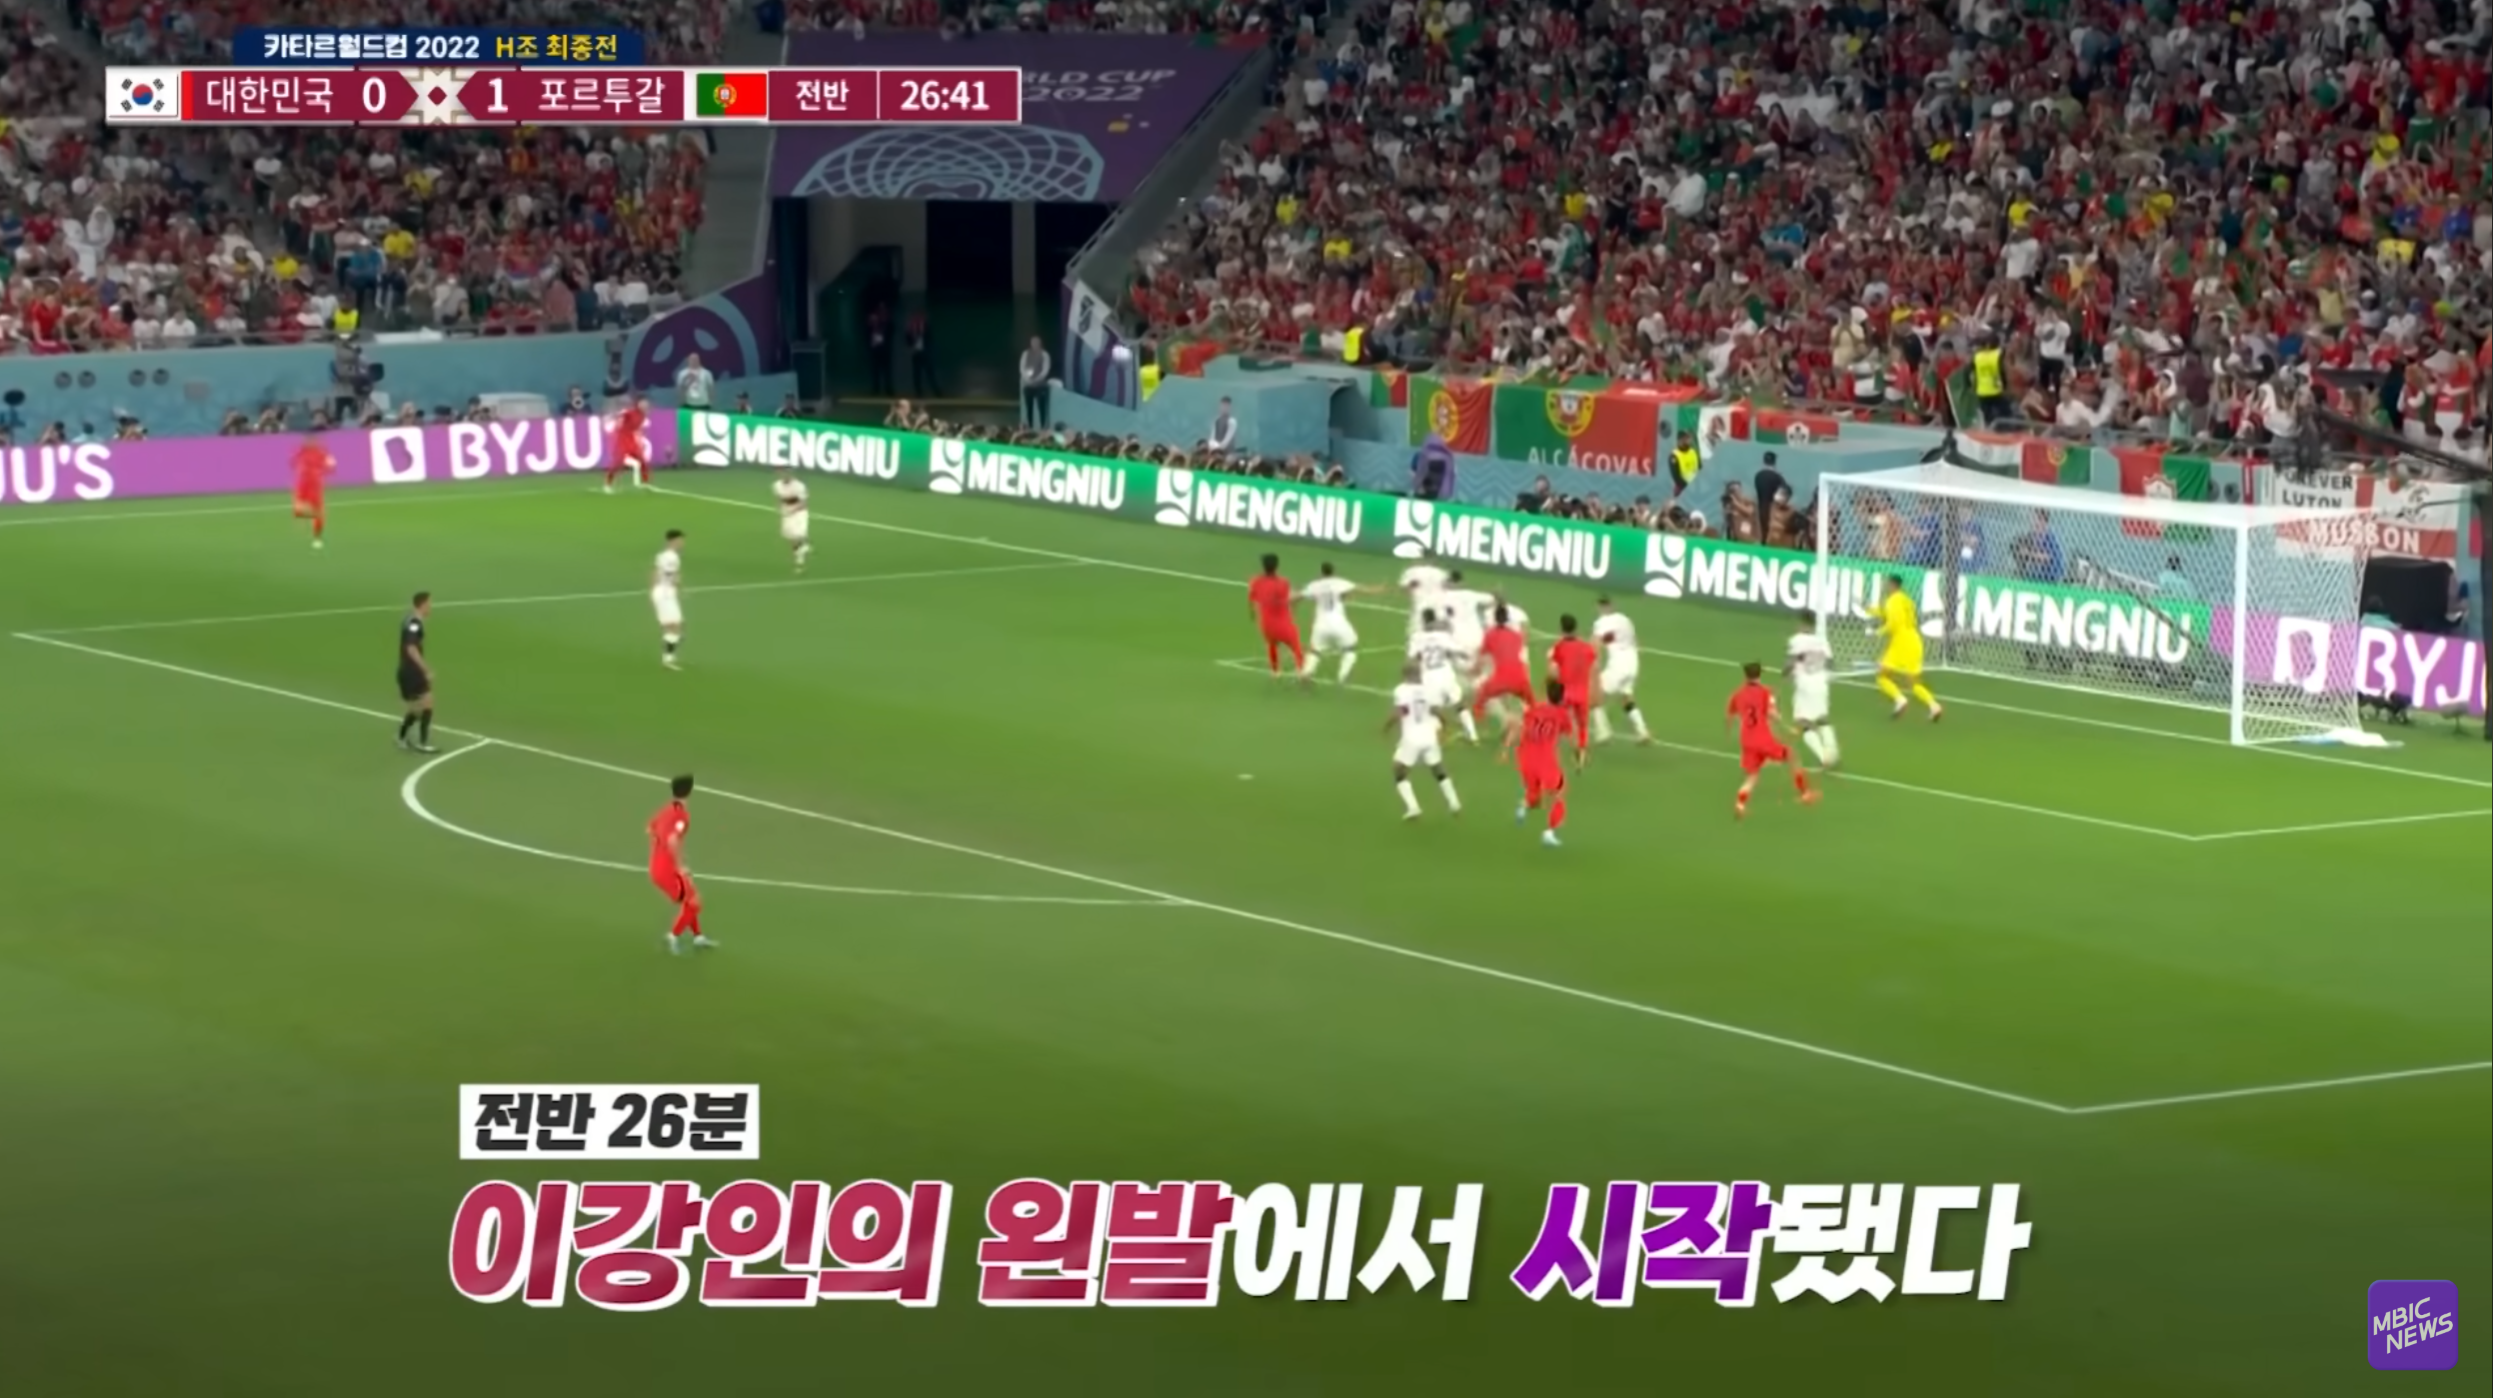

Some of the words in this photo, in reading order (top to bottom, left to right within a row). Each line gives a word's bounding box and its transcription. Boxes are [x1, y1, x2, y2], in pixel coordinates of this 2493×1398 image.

[1022, 70, 1089, 84] RLD
[1097, 69, 1177, 83] CUP
[0, 443, 114, 503] U'S
[735, 421, 901, 480] MENGNIU
[967, 446, 1126, 510] MENGNIU
[1195, 479, 1362, 543] MENGNIU
[1436, 511, 1611, 581] MENGNIU
[1972, 584, 2192, 665] MENGNIU
[2355, 626, 2487, 711] BYJ
